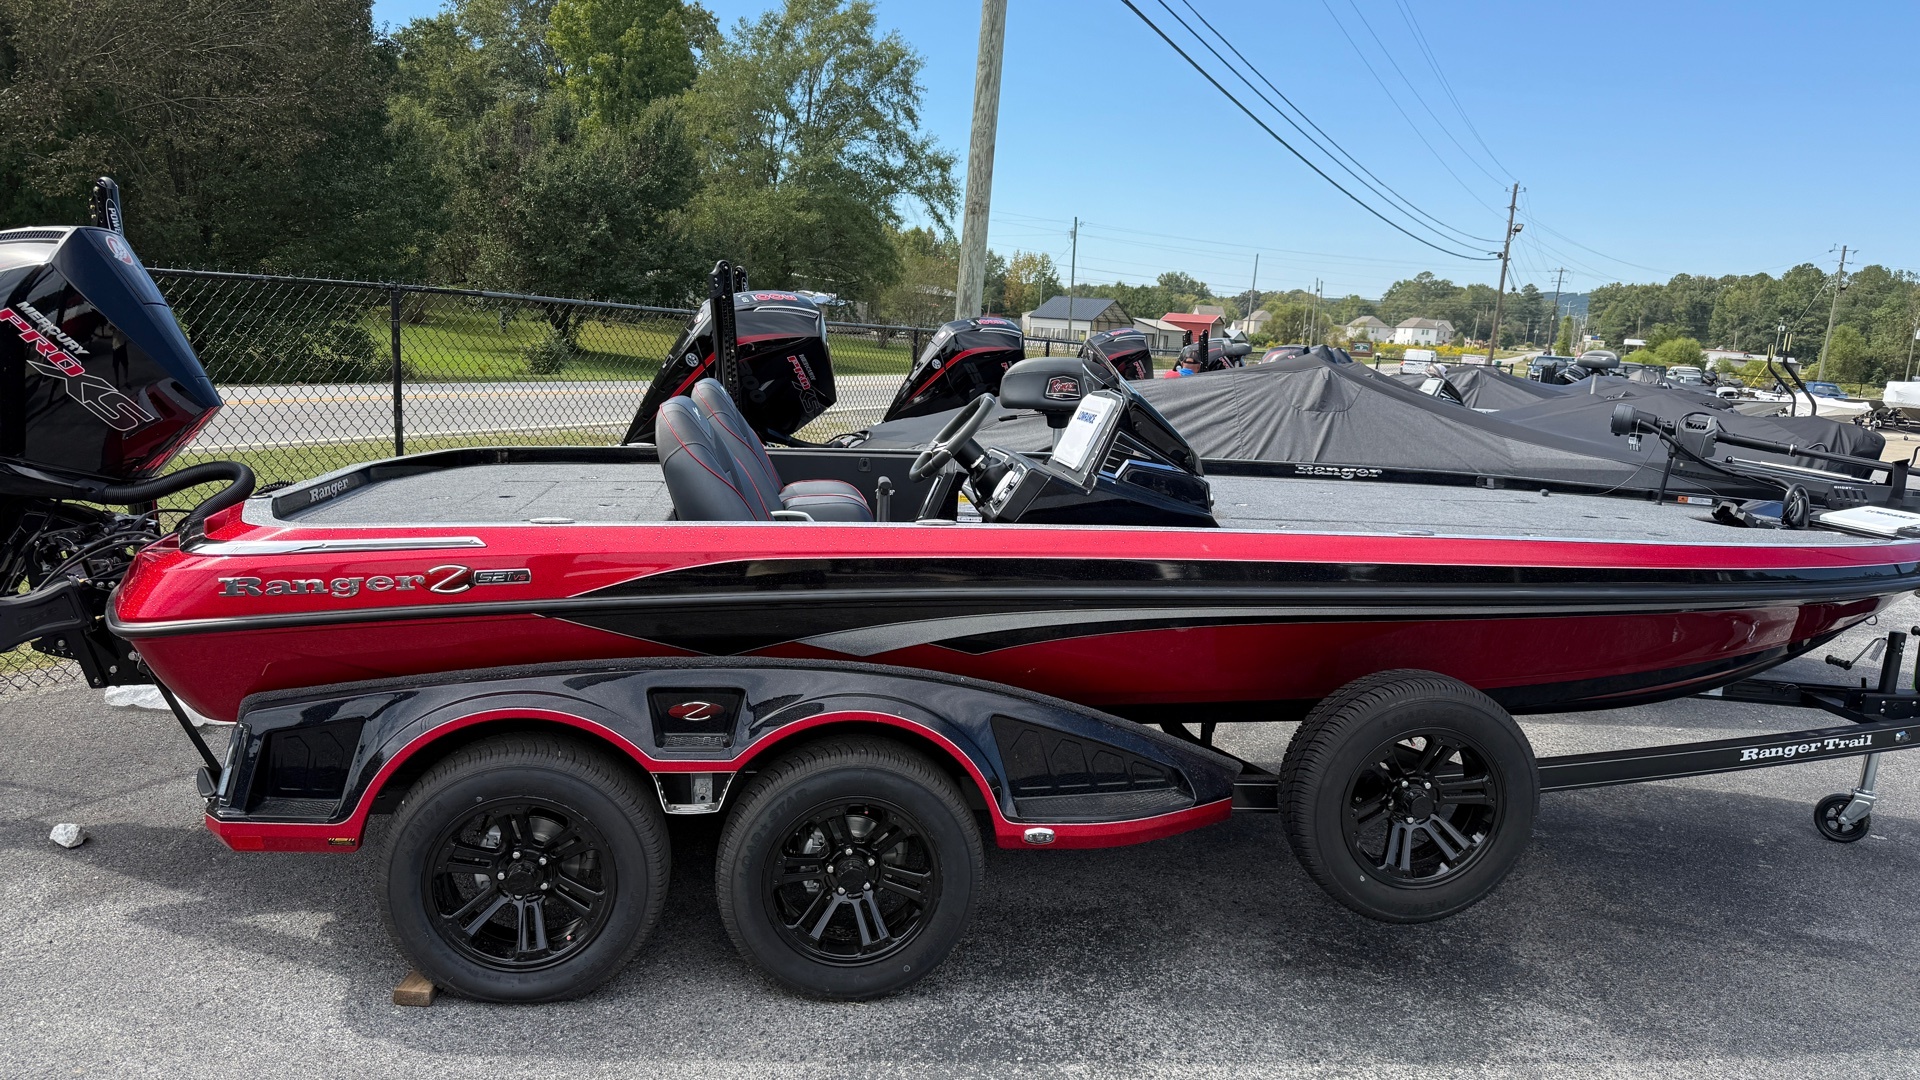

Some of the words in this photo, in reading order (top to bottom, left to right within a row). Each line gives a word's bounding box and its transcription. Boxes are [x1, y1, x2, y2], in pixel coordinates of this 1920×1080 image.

[108, 207, 121, 235] POWE
[0, 307, 85, 378] PRO
[16, 301, 90, 355] MERCURY
[787, 355, 811, 390] PRO
[26, 360, 155, 431] XS
[1295, 464, 1383, 479] Ranger
[310, 478, 348, 503] Ranger
[217, 574, 425, 598] Ranger
[428, 564, 470, 593] Z
[1739, 741, 1822, 762] Ranger
[1823, 735, 1873, 751] Trail
